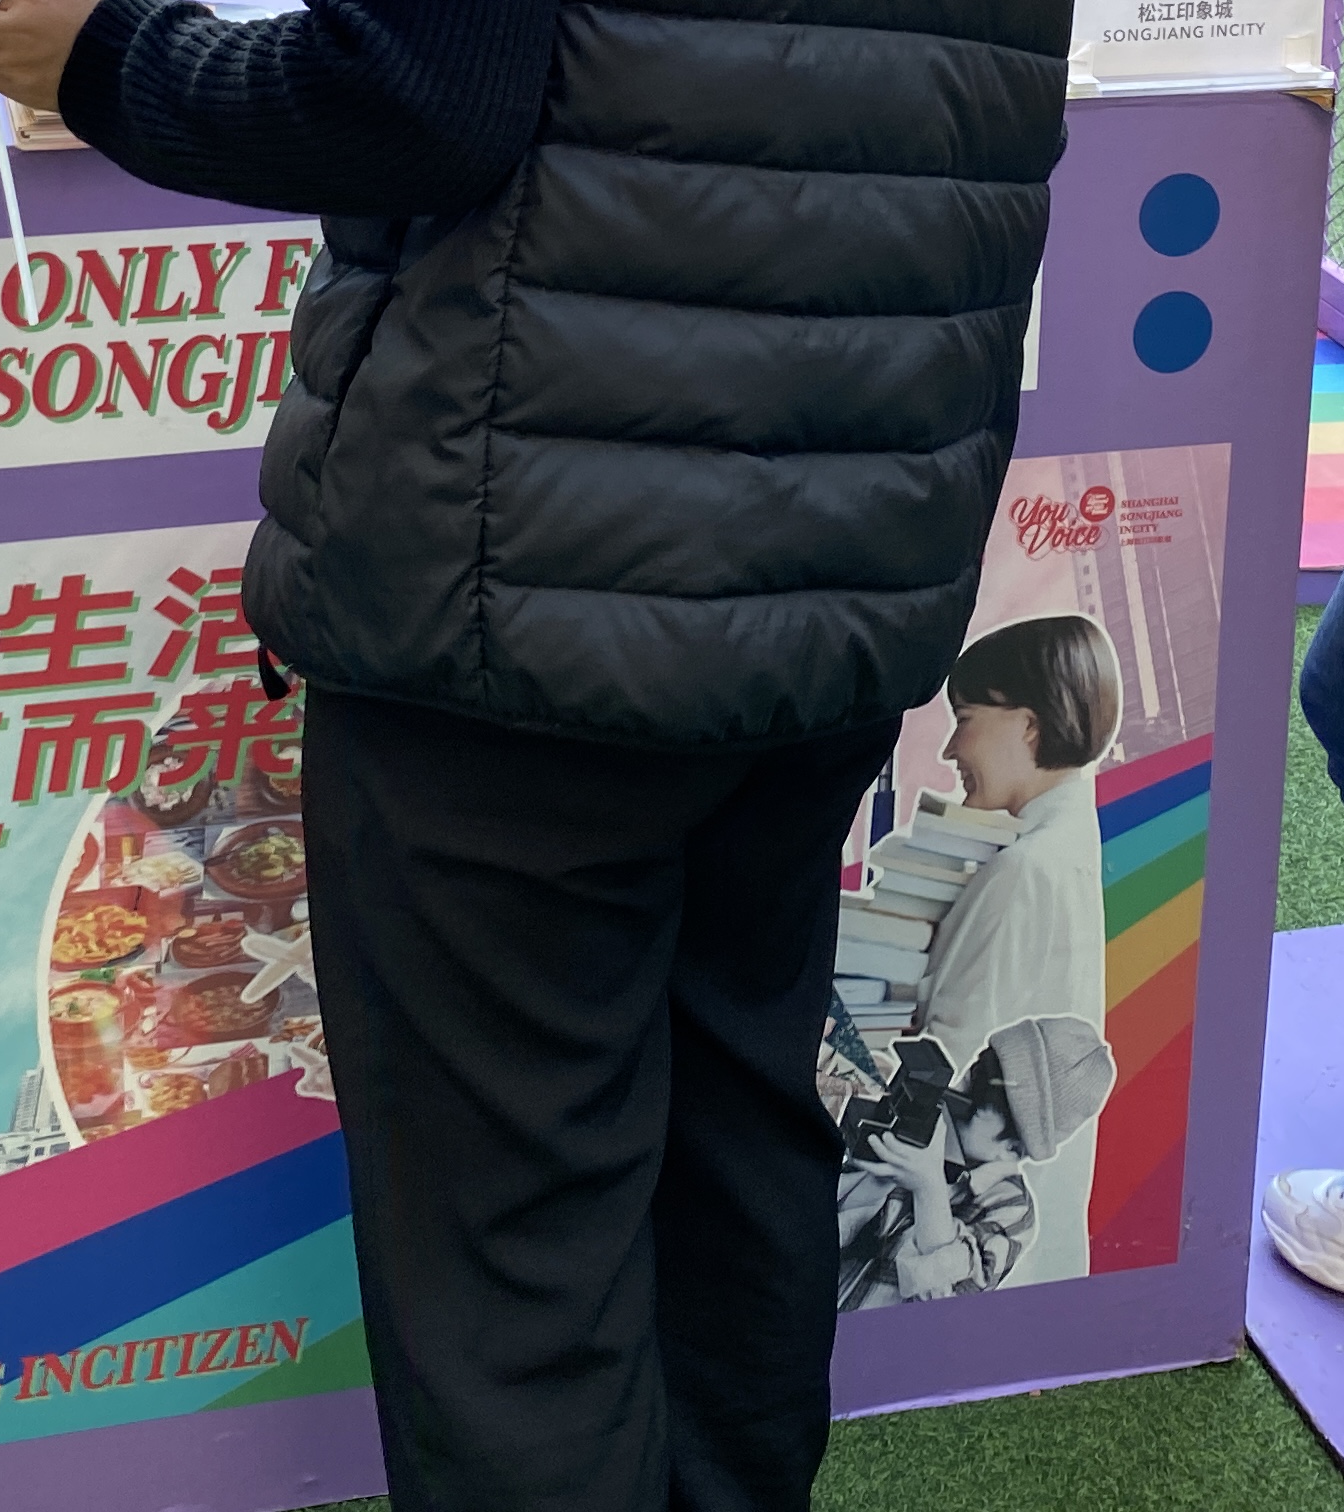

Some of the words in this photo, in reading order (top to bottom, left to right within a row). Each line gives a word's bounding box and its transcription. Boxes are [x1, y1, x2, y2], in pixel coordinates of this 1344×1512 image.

[1102, 25, 1205, 44] SONGJIANG
[1210, 22, 1267, 39] INCITY
[0, 240, 251, 333] ONLY
[254, 236, 321, 317] F
[1010, 494, 1071, 529] You
[1119, 508, 1184, 521] SONGJIANG
[1120, 495, 1180, 509] SHANGHAI
[1017, 521, 1103, 556] Voice
[1118, 523, 1159, 535] INCITY
[14, 1316, 313, 1404] INCITIZEN
